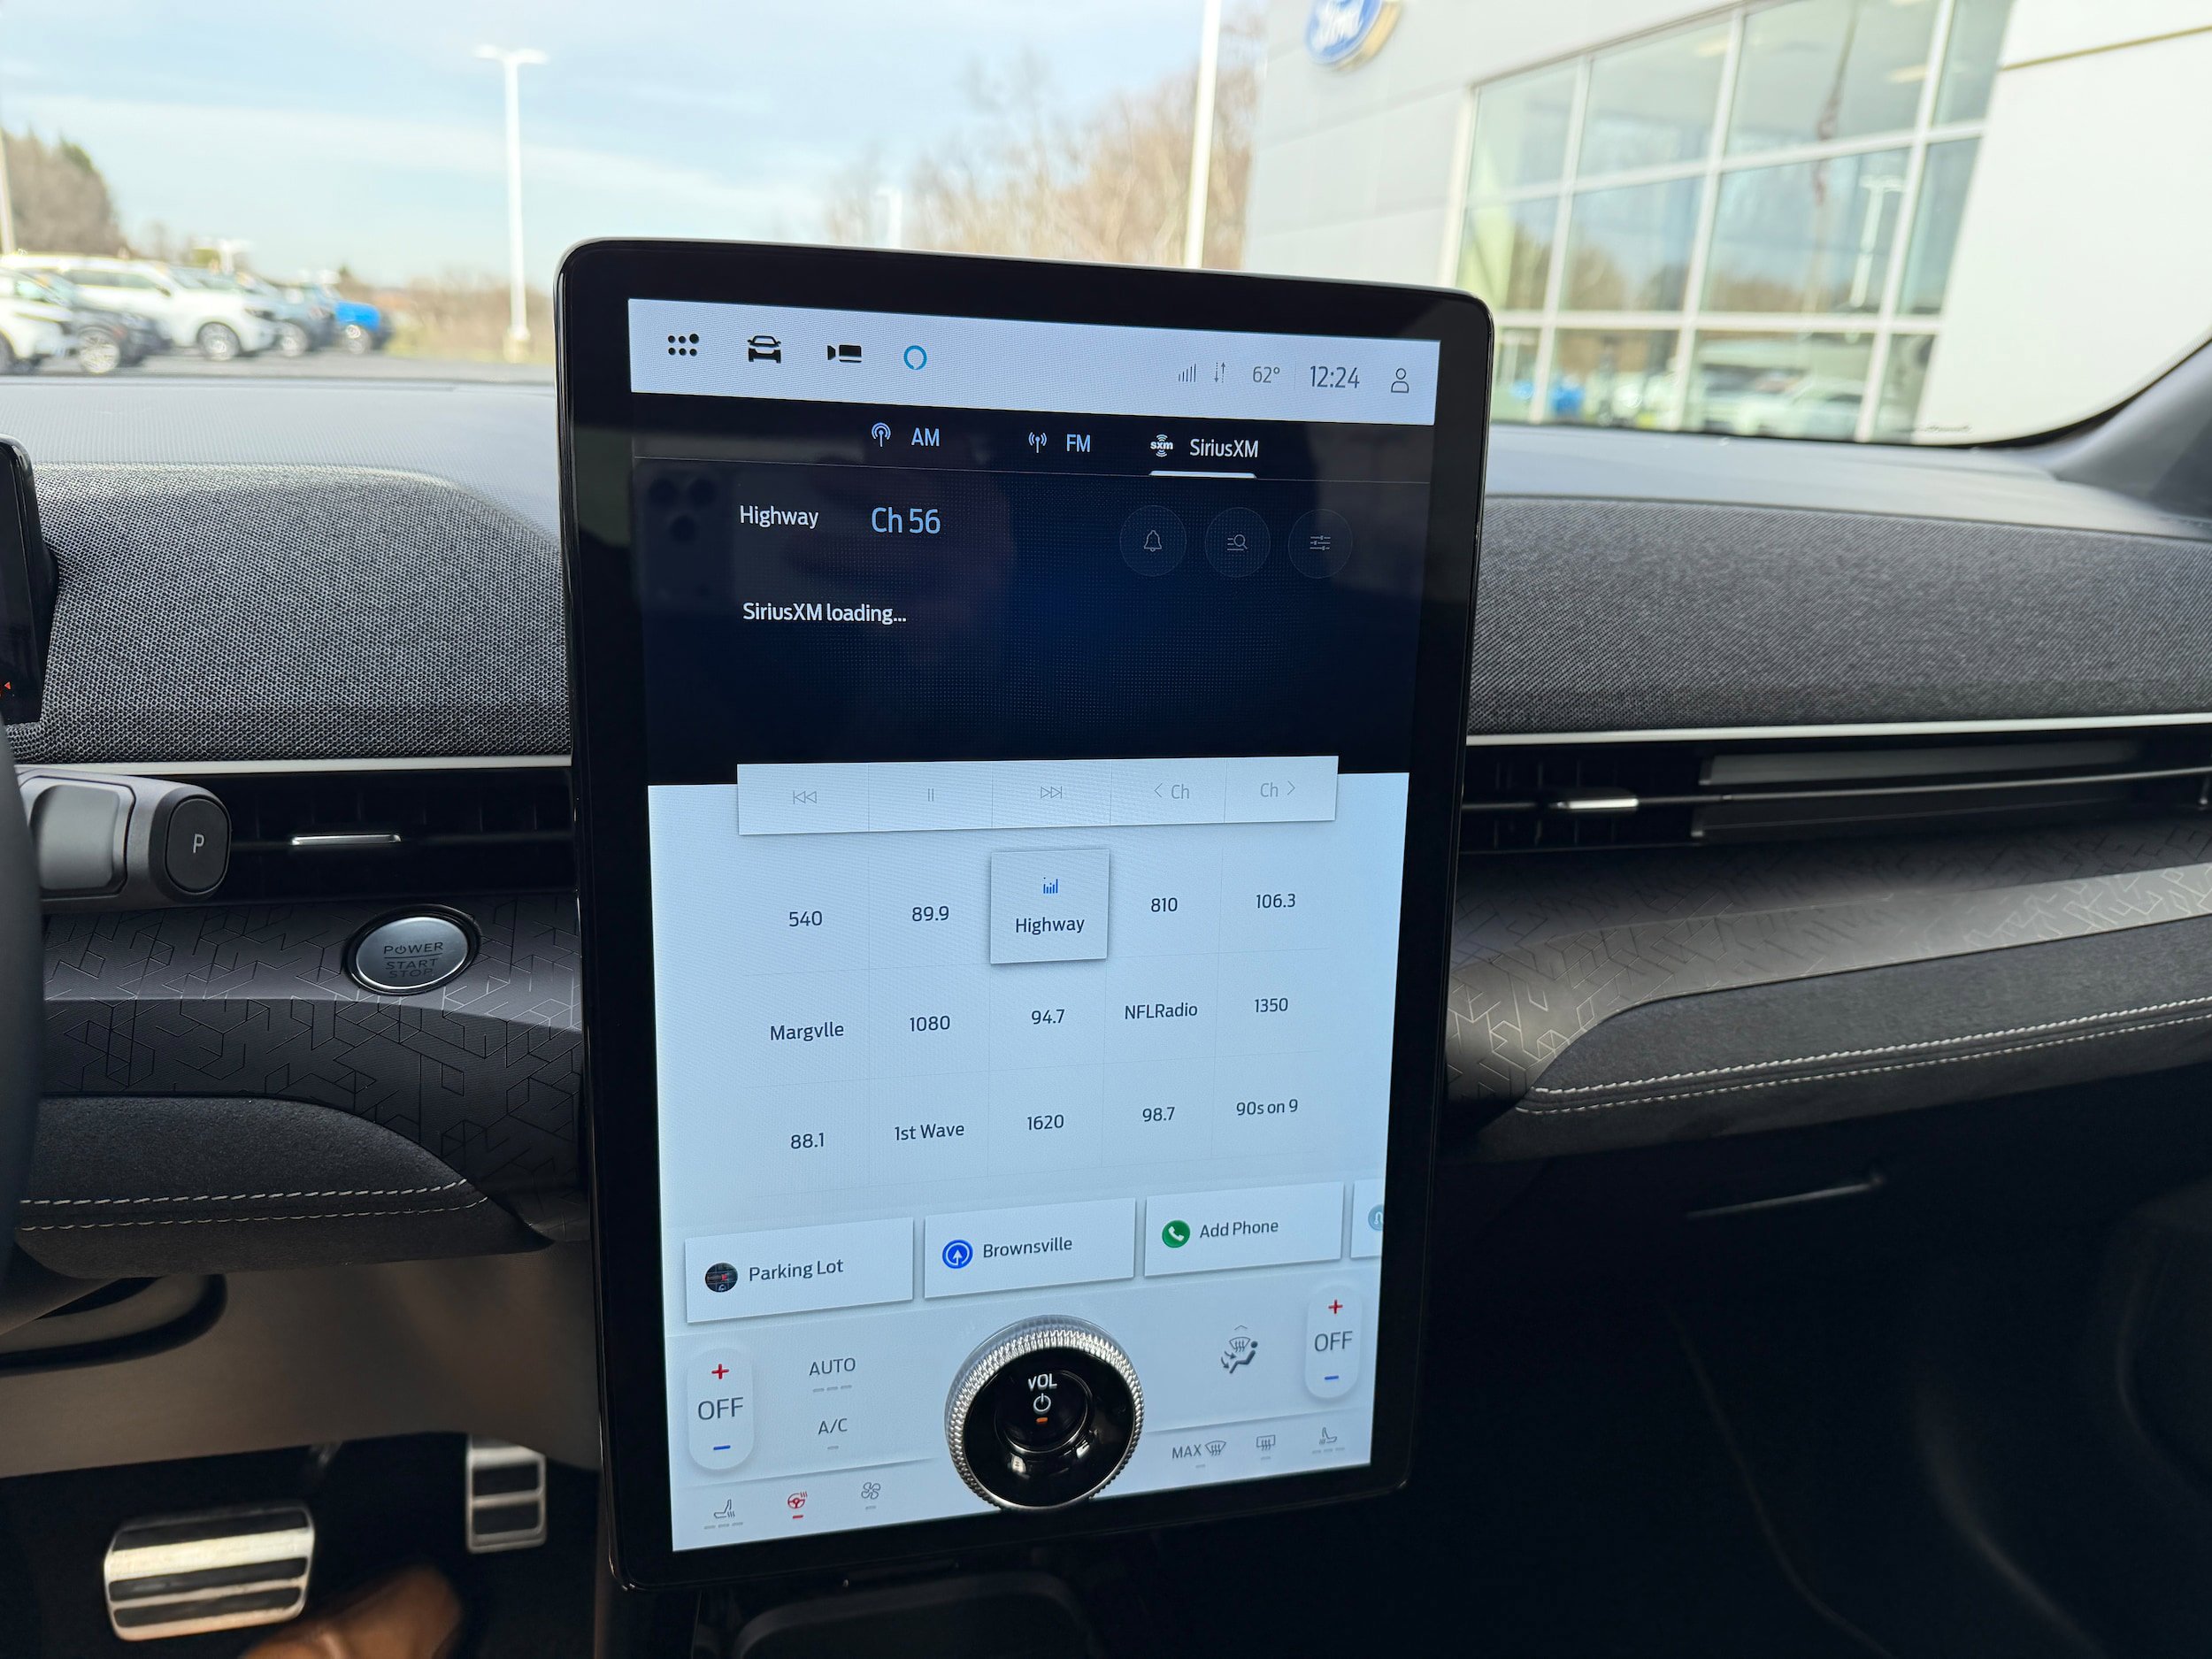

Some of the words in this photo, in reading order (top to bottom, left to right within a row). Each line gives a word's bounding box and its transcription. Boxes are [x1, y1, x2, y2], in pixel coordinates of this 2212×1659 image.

[1310, 365, 1360, 389] 12:24
[911, 428, 940, 447] AM
[1066, 434, 1091, 453] FM
[1189, 439, 1259, 458] SiriusXM
[740, 506, 818, 529] Highway
[871, 507, 902, 533] Ch
[909, 510, 941, 534] 56
[743, 603, 822, 621] SiriusXM
[1171, 784, 1189, 799] Ch
[1261, 782, 1279, 798] Ch
[193, 834, 204, 853] P
[1151, 898, 1178, 912] 810
[1256, 894, 1295, 909] 106.3
[789, 910, 822, 926] 540
[912, 906, 949, 922] 89.9
[1016, 918, 1085, 935] Highway
[386, 959, 438, 969] START
[389, 969, 433, 978] STOP
[1125, 1003, 1198, 1019] NFLRadio
[1255, 998, 1288, 1013] 1350
[910, 1016, 950, 1032] 1080
[1032, 1010, 1065, 1025] 94.7
[771, 1022, 844, 1041] Margvlle
[1142, 1107, 1175, 1122] 98.7
[1236, 1101, 1263, 1115] 90s
[1267, 1102, 1285, 1113] on
[1289, 1099, 1298, 1112] 9
[1027, 1115, 1064, 1130] 1620
[791, 1133, 825, 1148] 88.1
[895, 1126, 916, 1141] 1st
[921, 1124, 964, 1139] Wave
[1200, 1224, 1229, 1238] Add
[1233, 1220, 1279, 1235] Phone
[983, 1236, 1072, 1258] Brownsville
[749, 1262, 813, 1281] Parking
[818, 1259, 843, 1275] Lot
[1315, 1331, 1353, 1351] OFF
[810, 1357, 856, 1376] AUTO
[1028, 1373, 1057, 1392] VOL
[698, 1397, 743, 1420] OFF
[818, 1418, 848, 1434] A/C
[1172, 1444, 1202, 1459] MAX
